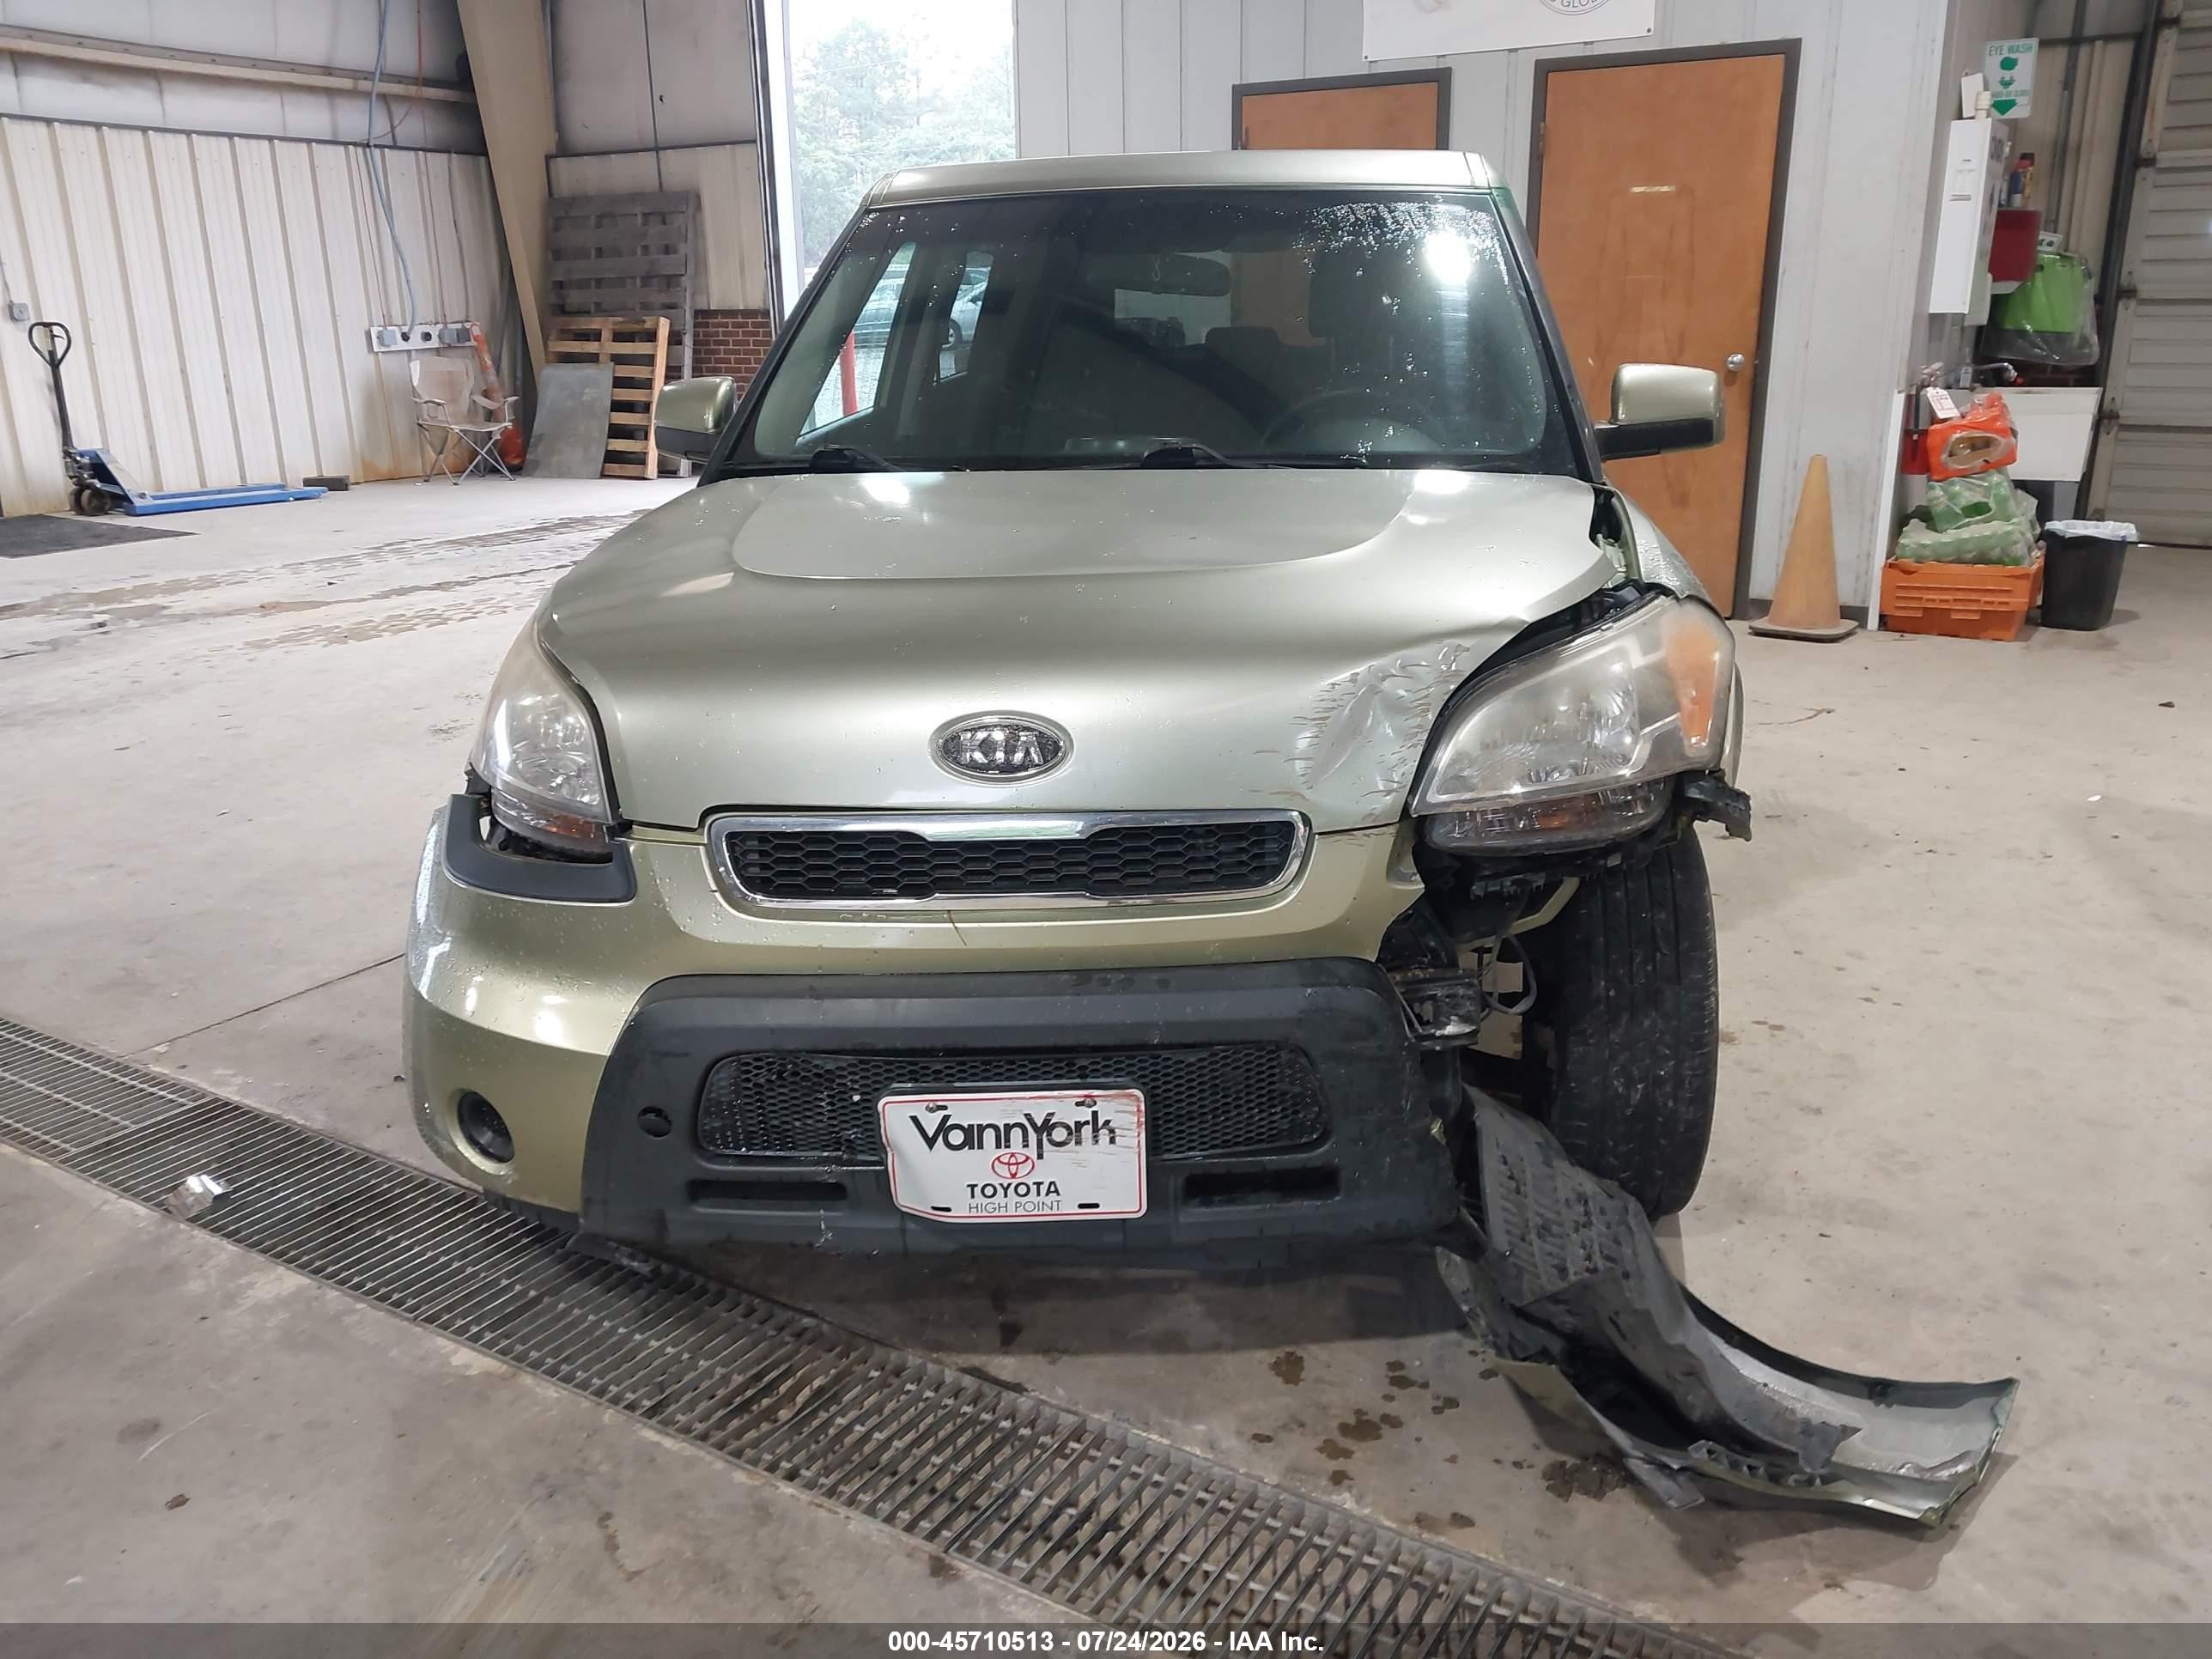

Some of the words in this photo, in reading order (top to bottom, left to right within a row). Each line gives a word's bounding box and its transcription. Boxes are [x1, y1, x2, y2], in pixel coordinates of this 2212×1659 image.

[1989, 45, 2005, 57] EYE
[2007, 43, 2033, 55] WASH
[959, 730, 1044, 765] KIA
[966, 1181, 1061, 1200] TOYOTA
[968, 1200, 1008, 1214] HIGH
[1014, 1200, 1062, 1213] POINT
